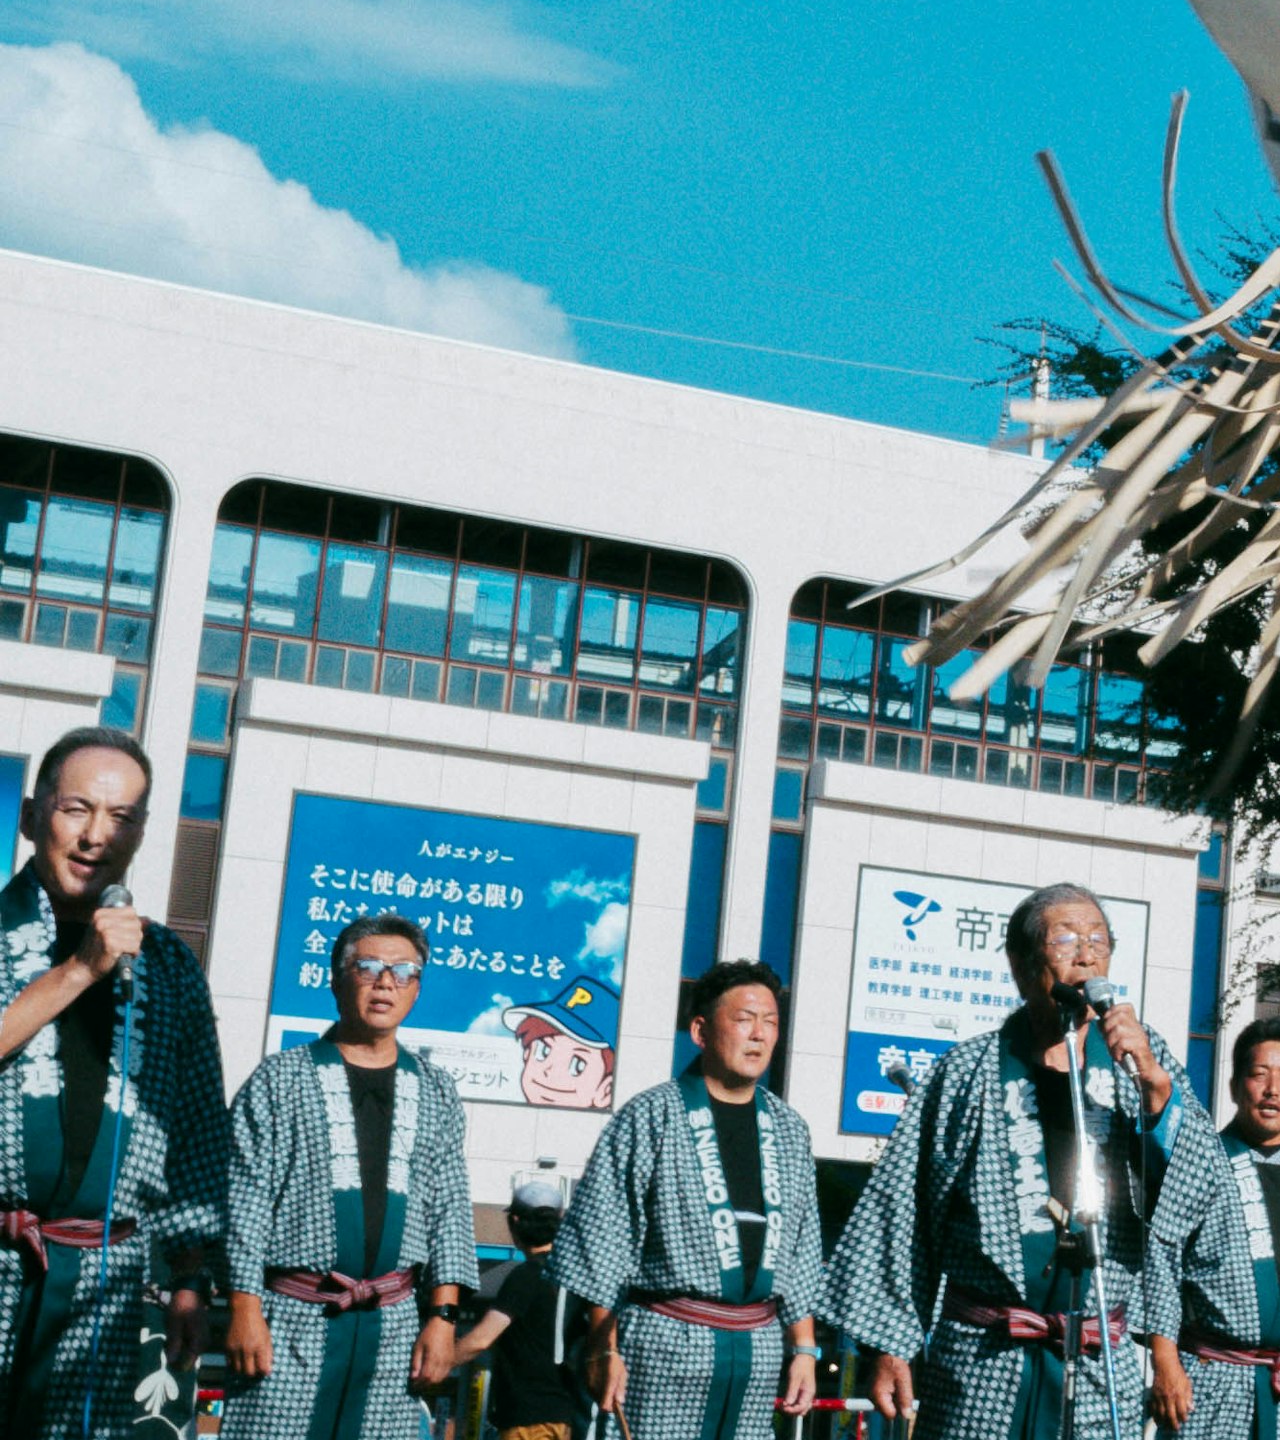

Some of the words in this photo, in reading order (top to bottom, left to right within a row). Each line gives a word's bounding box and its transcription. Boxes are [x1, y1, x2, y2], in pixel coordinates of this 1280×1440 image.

[417, 839, 515, 865] 人がエナジー
[309, 863, 525, 911] そこに使命がある限り
[868, 956, 902, 972] 医学部
[867, 980, 912, 998] 教育学部
[919, 986, 963, 1003] 理工学部
[712, 1208, 742, 1271] ONE
[761, 1211, 783, 1271] ONE
